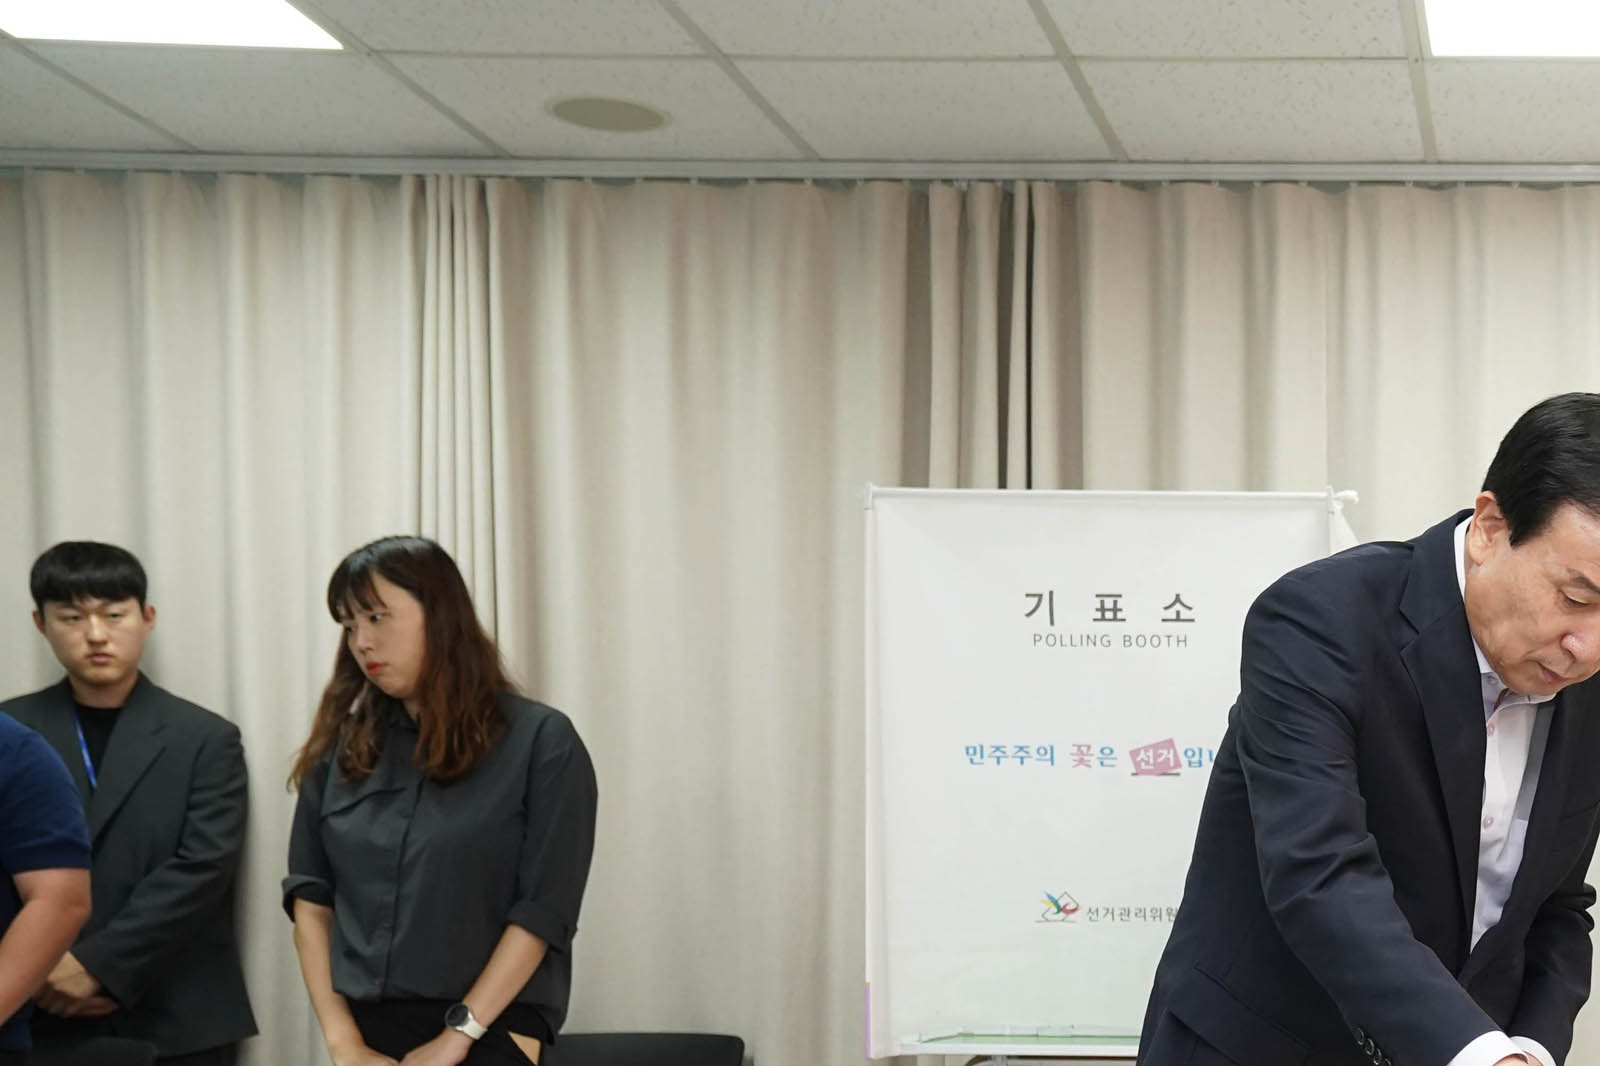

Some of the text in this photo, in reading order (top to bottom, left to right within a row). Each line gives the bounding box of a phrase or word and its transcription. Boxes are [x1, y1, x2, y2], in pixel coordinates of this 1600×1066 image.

[1034, 634, 1187, 648] POLLING BOOTH
[965, 744, 1214, 769] 민주주의 꽃은 선거입
[1086, 906, 1178, 921] 선거관리위원
